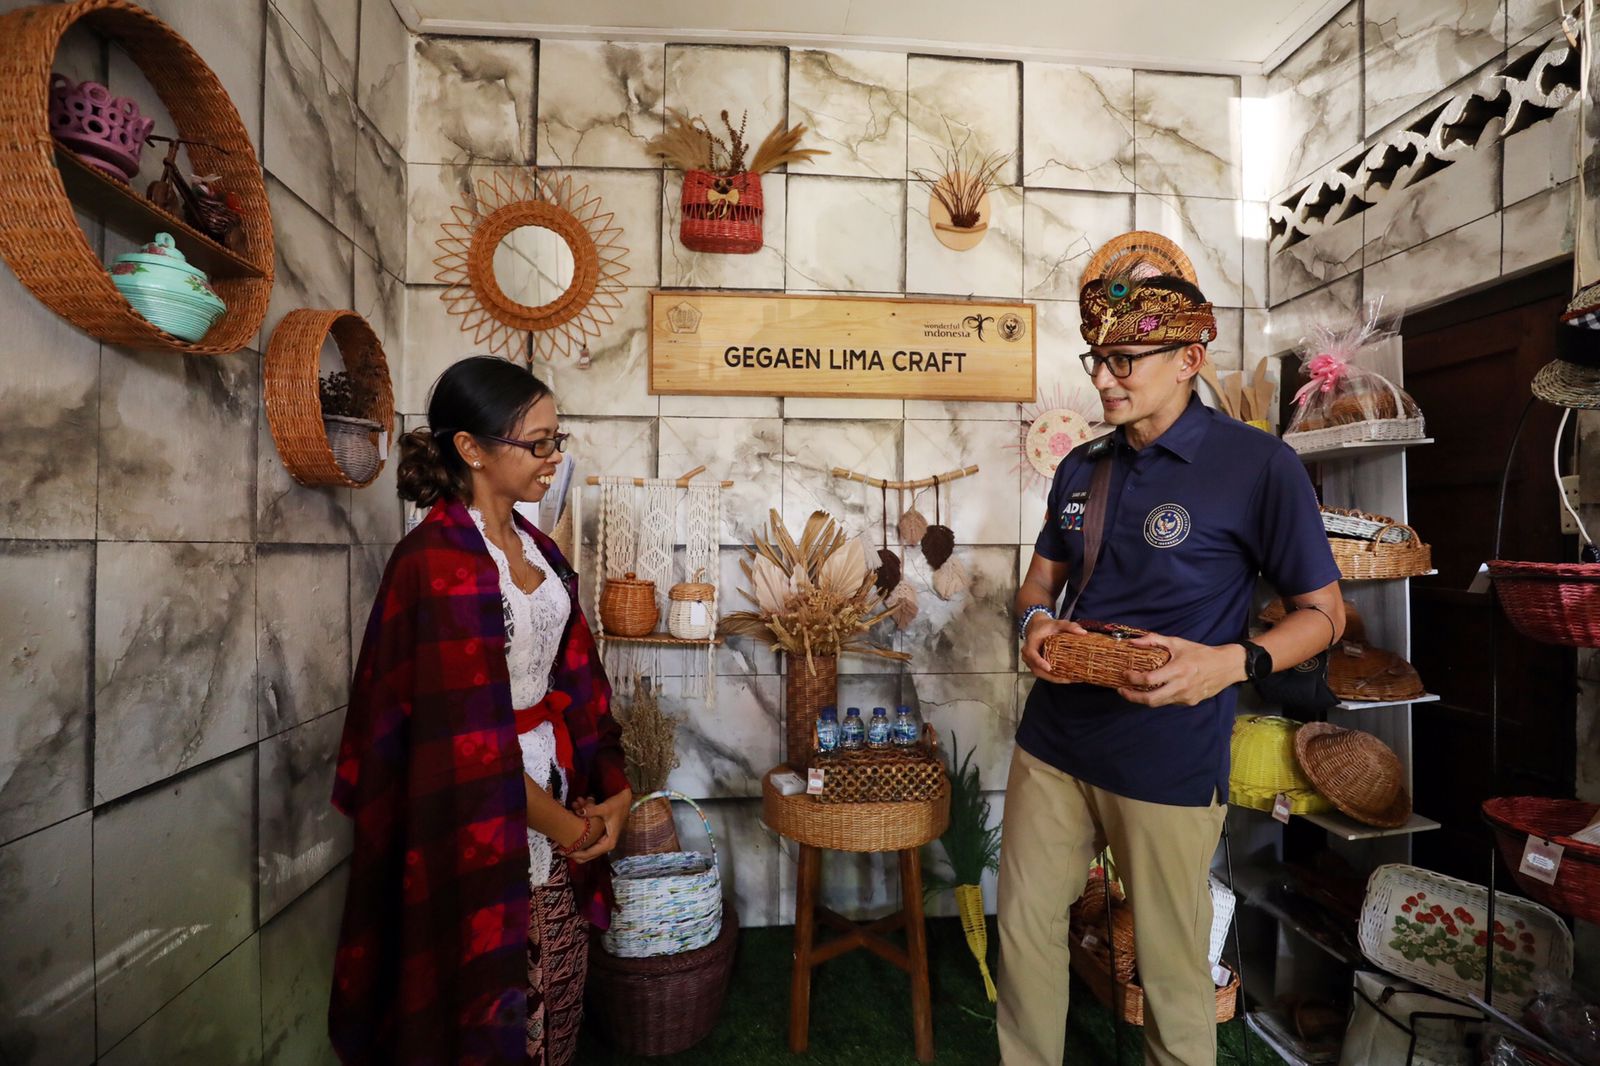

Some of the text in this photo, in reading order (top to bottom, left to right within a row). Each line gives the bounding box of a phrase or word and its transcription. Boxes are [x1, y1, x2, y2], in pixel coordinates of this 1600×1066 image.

[923, 322, 960, 331] wonderful
[923, 329, 971, 338] indonesia
[724, 346, 967, 373] GEGAEN LIMA CRAFT
